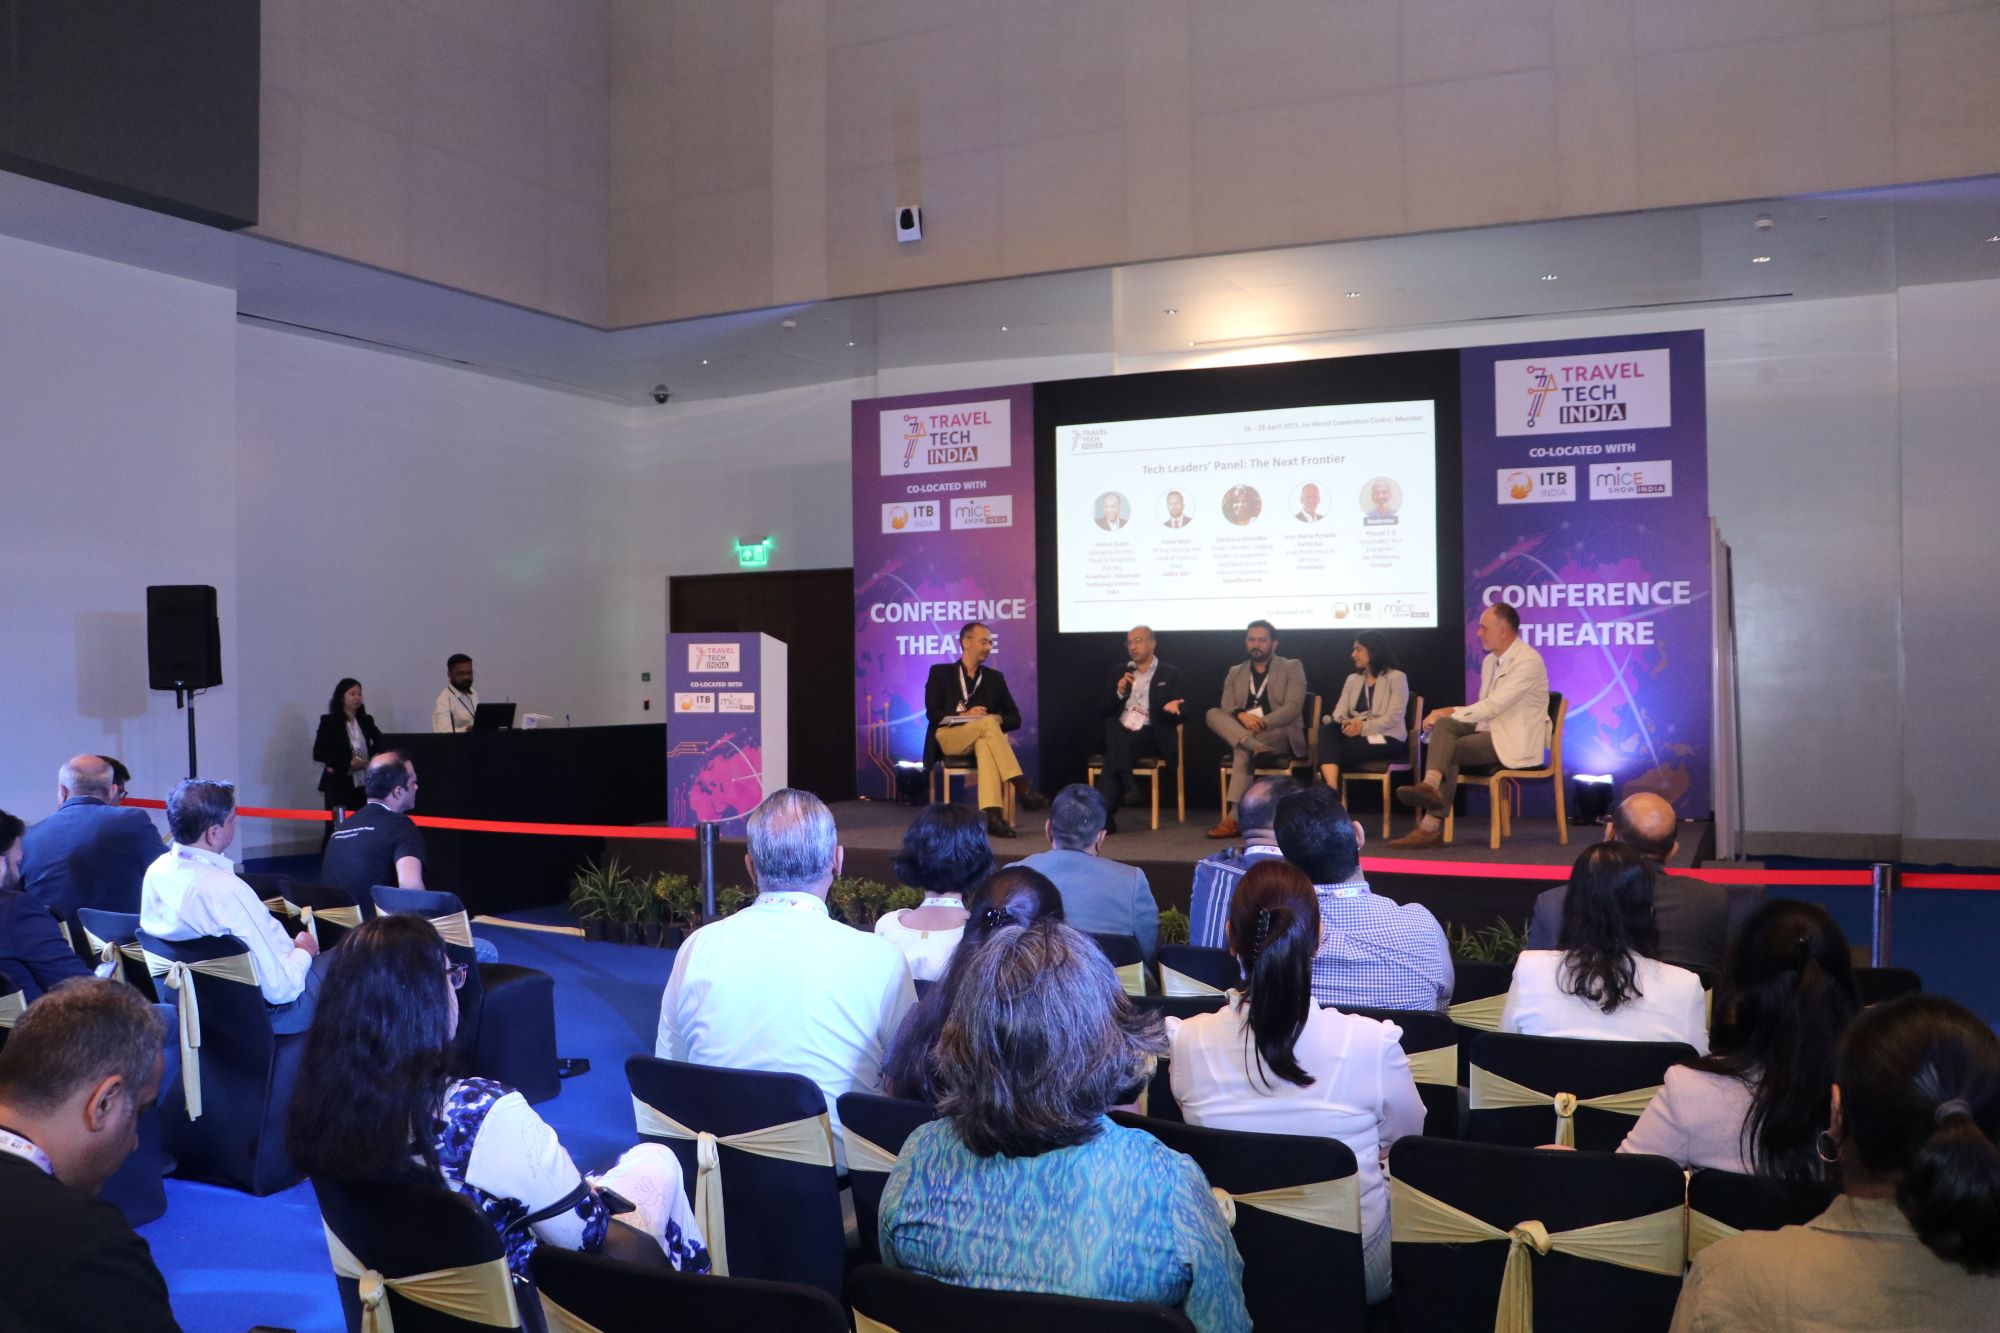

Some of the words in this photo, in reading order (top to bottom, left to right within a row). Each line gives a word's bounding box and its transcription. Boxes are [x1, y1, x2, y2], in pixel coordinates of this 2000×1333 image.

[1560, 362, 1645, 383] TRAVEL
[1561, 384, 1617, 402] TECH
[929, 411, 992, 429] TRAVEL
[1561, 403, 1624, 424] INDIA
[1267, 423, 1282, 432] April
[1312, 420, 1332, 428] World
[1333, 418, 1369, 426] Convention
[929, 431, 971, 446] TECH
[929, 447, 977, 465] INDIA
[1529, 445, 1602, 458] CO-LOCATED
[1605, 443, 1636, 455] WITH
[1142, 464, 1165, 474] Tech
[1214, 459, 1247, 471] Panel:
[1250, 458, 1270, 469] The
[1272, 457, 1299, 468] Next
[1301, 453, 1346, 466] Frontier
[1540, 472, 1567, 486] ITB
[906, 482, 962, 494] CO-LOCATED
[963, 480, 987, 491] WITH
[1541, 488, 1567, 497] INDIA
[1608, 486, 1635, 494] SHOW
[1637, 485, 1664, 493] INDIA
[913, 505, 934, 518] ITB
[914, 519, 935, 528] INDIA
[1482, 580, 1691, 609] CONFERENCE
[870, 598, 1026, 623] CONFERENCE
[1353, 602, 1372, 612] ITB
[1519, 621, 1655, 647] THEATRE
[896, 634, 999, 656] THEAE
[696, 695, 711, 704] ITB
